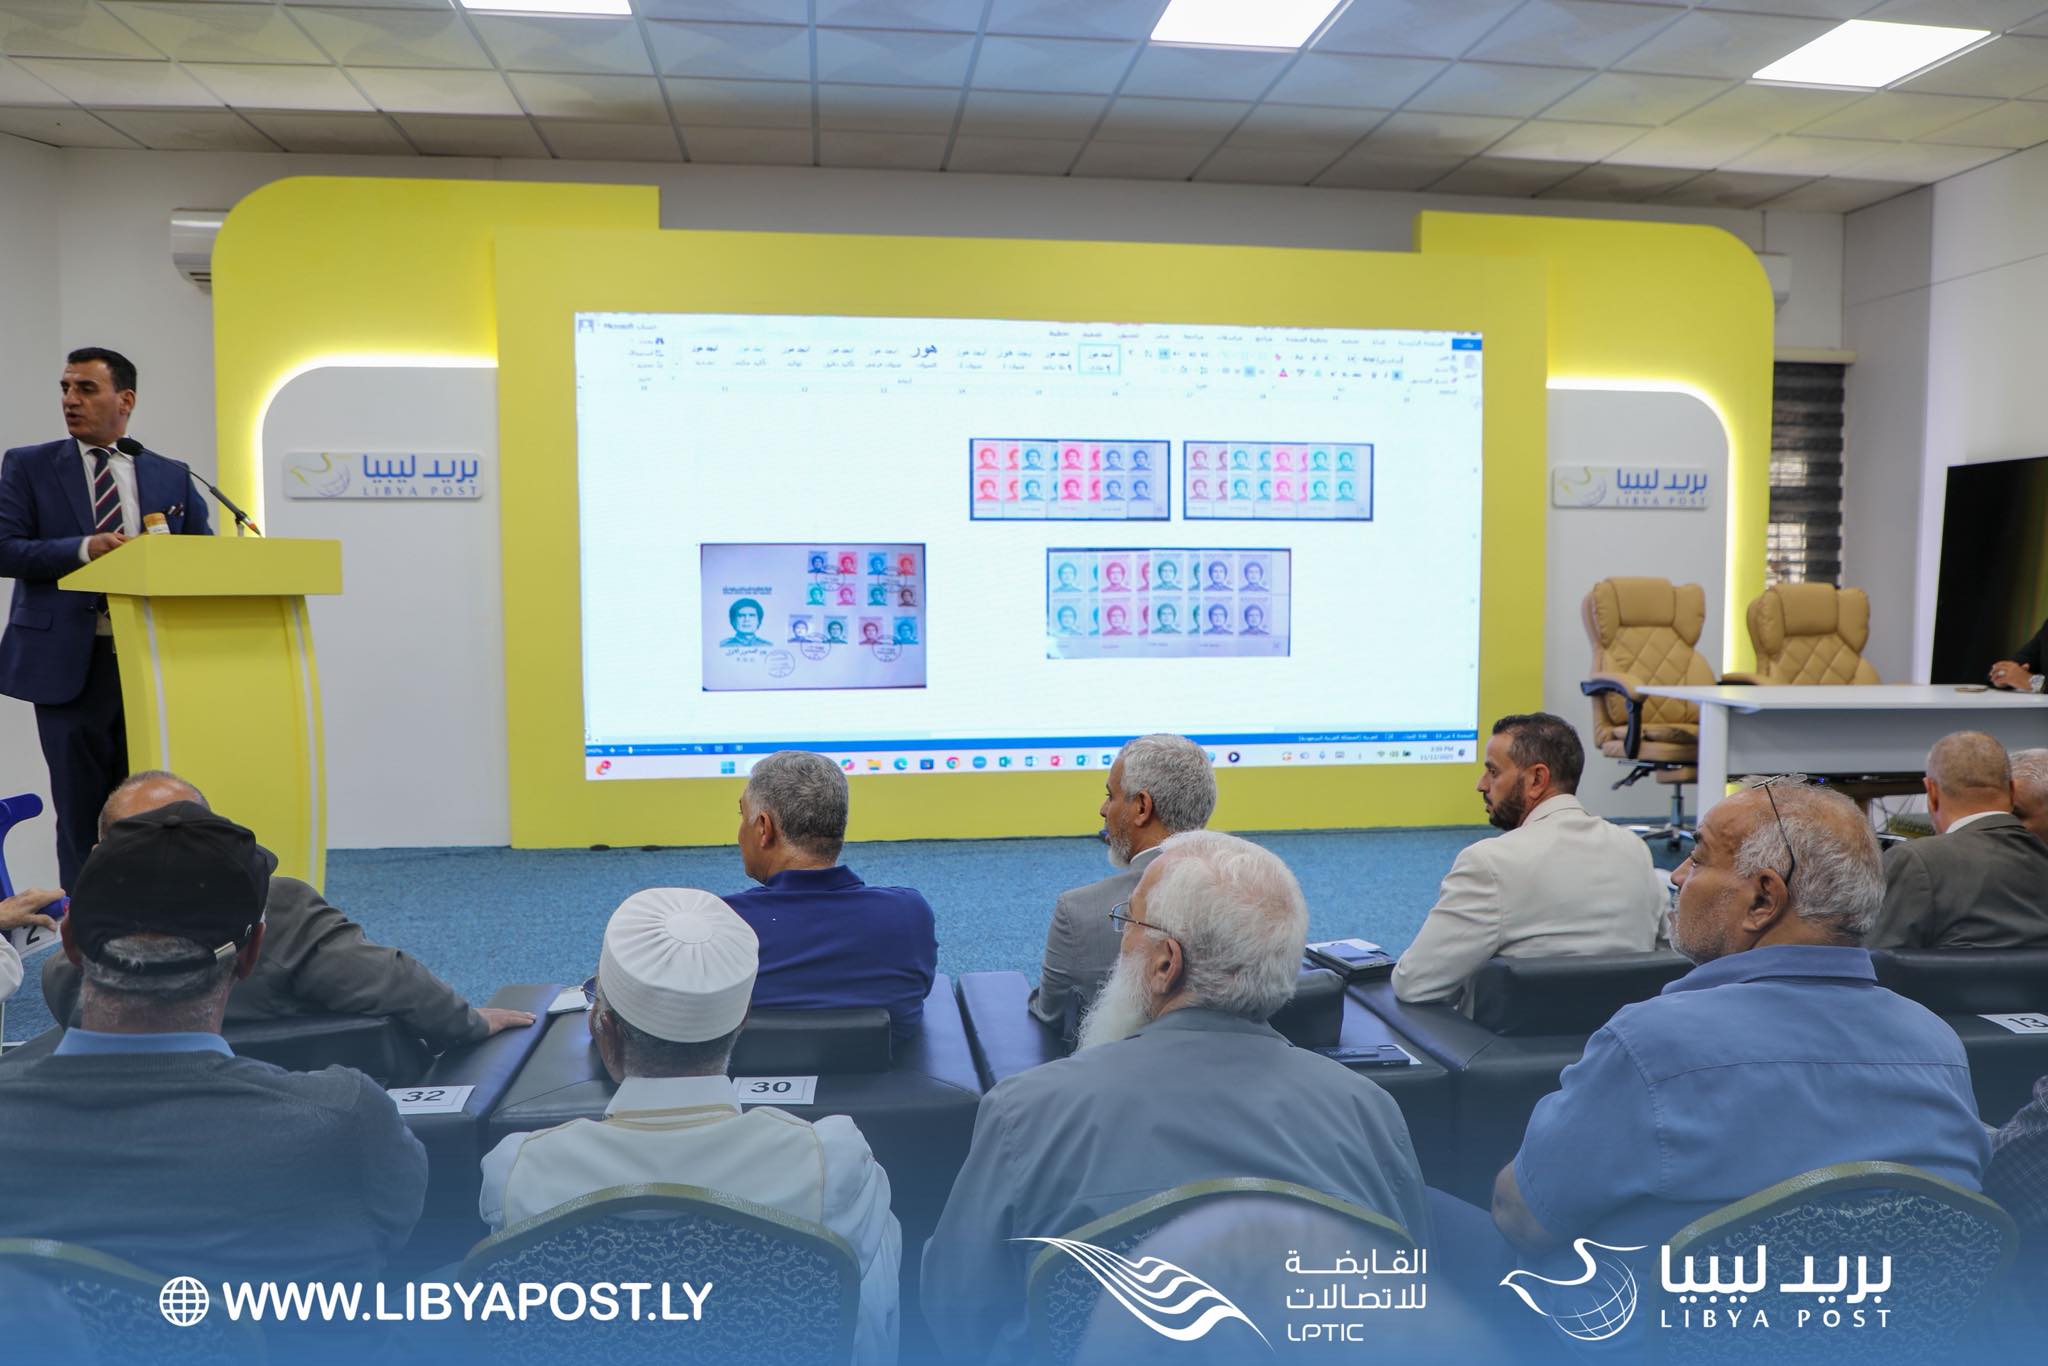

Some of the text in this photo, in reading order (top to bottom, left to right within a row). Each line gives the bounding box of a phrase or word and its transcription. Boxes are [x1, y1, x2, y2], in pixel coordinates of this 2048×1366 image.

[362, 454, 478, 484] بريد ليبيا
[1616, 468, 1708, 495] بريد ليبيا
[363, 486, 477, 496] LIBYA POST
[1616, 497, 1706, 505] LIBYA POST
[750, 1081, 793, 1094] 30
[401, 1089, 446, 1103] 32
